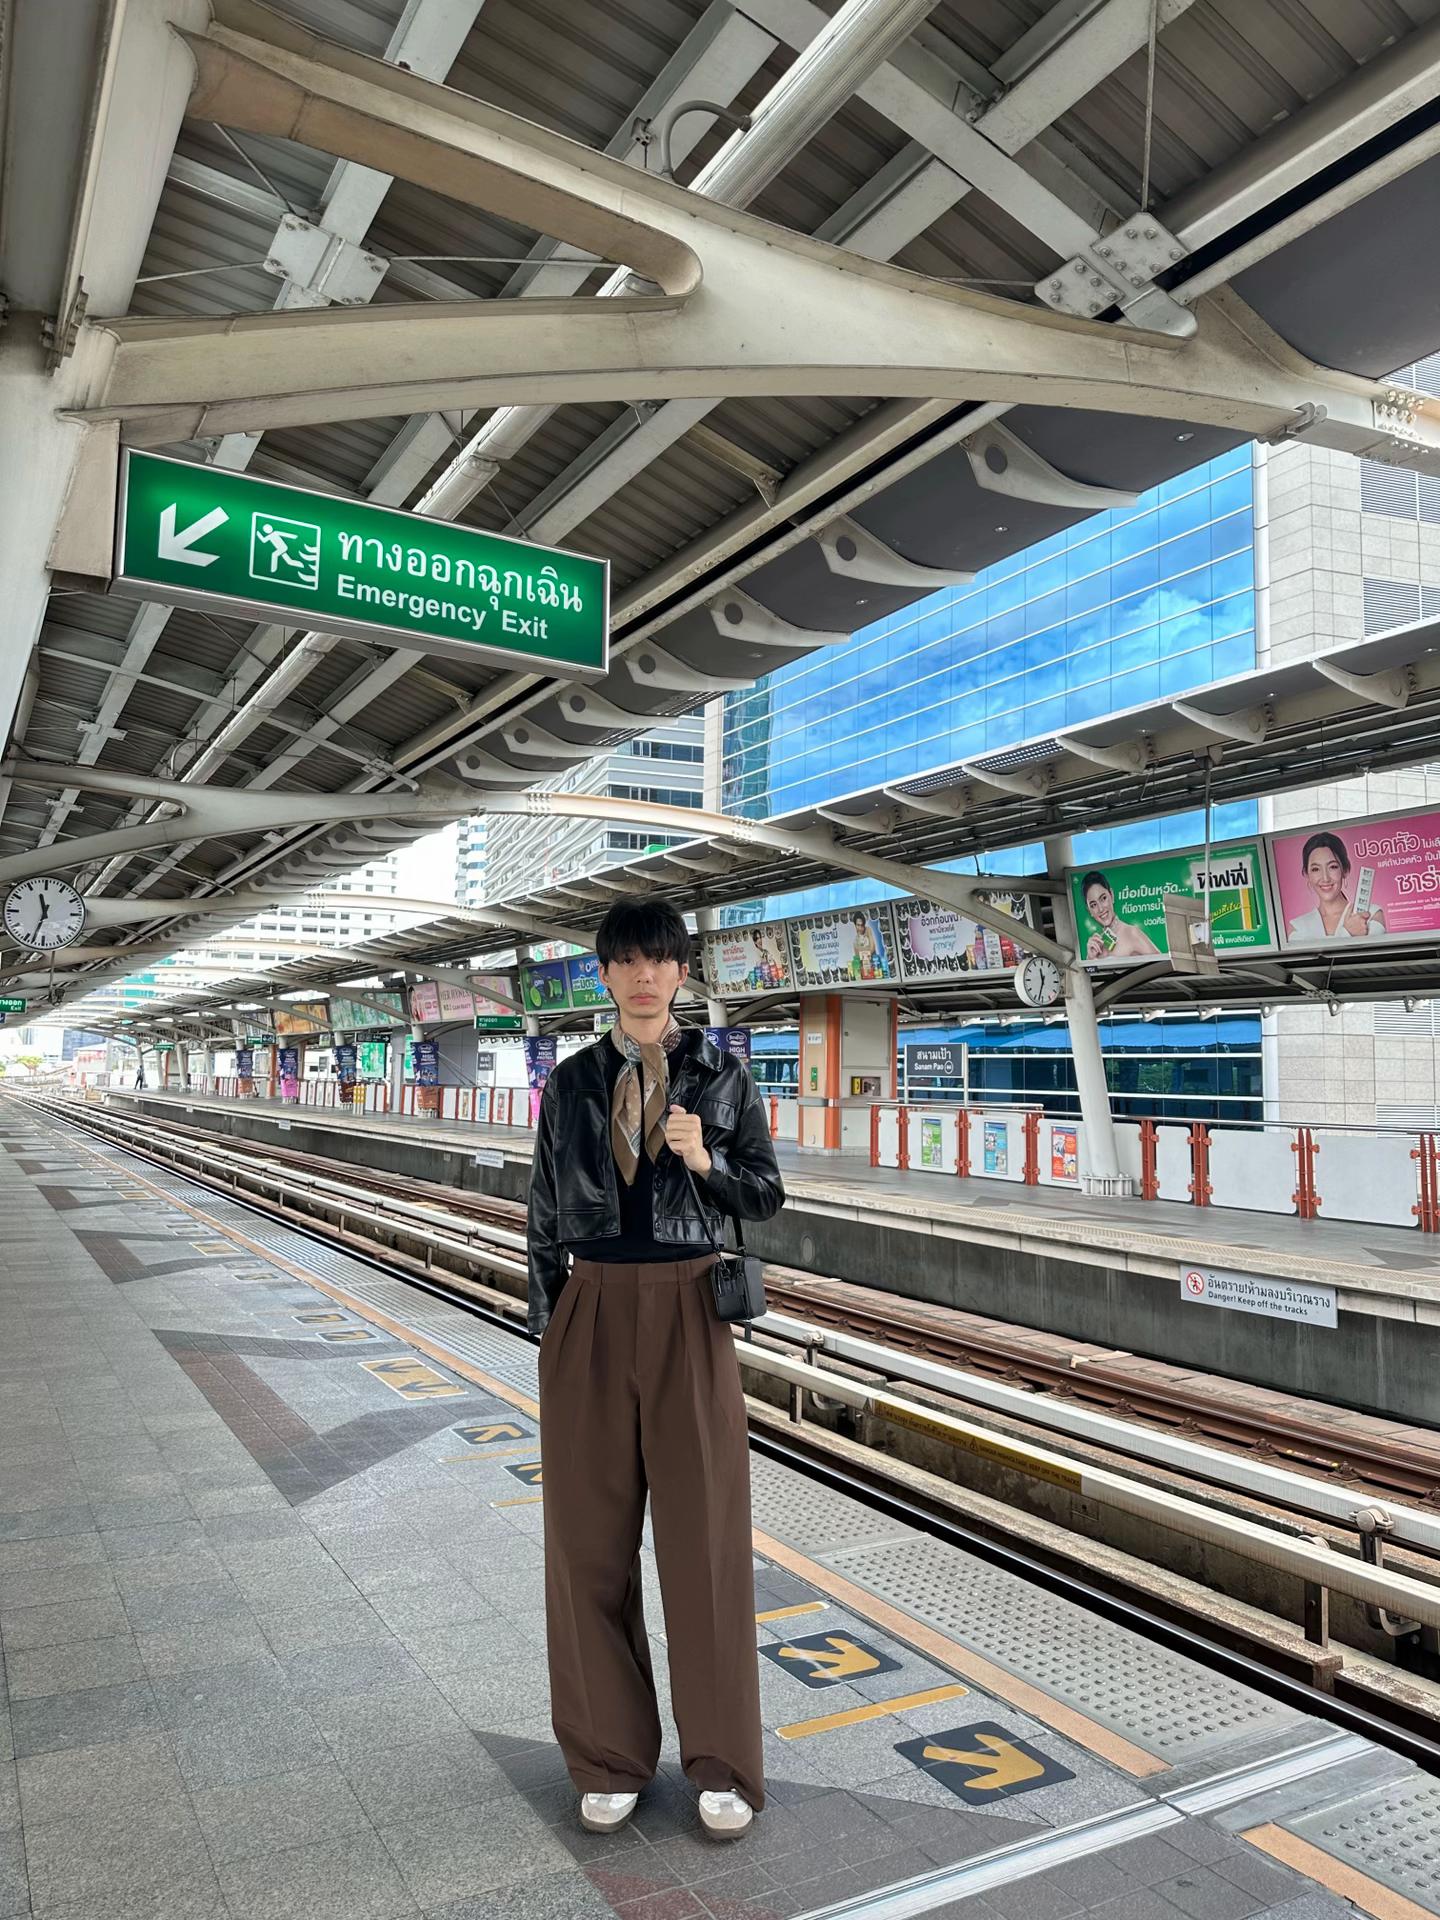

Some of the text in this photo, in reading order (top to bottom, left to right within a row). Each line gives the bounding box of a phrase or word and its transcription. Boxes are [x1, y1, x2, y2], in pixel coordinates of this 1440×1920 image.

[337, 531, 583, 612] ทางออกฉุกเฉิน
[337, 573, 548, 640] Emergency Exit
[1354, 831, 1420, 858] ปวดหัว
[914, 1062, 932, 1071] Sanam
[933, 1062, 944, 1071] Pao
[916, 1047, 952, 1060] สนามเป้า
[1208, 1290, 1308, 1316] Danger! Keep off the tracks
